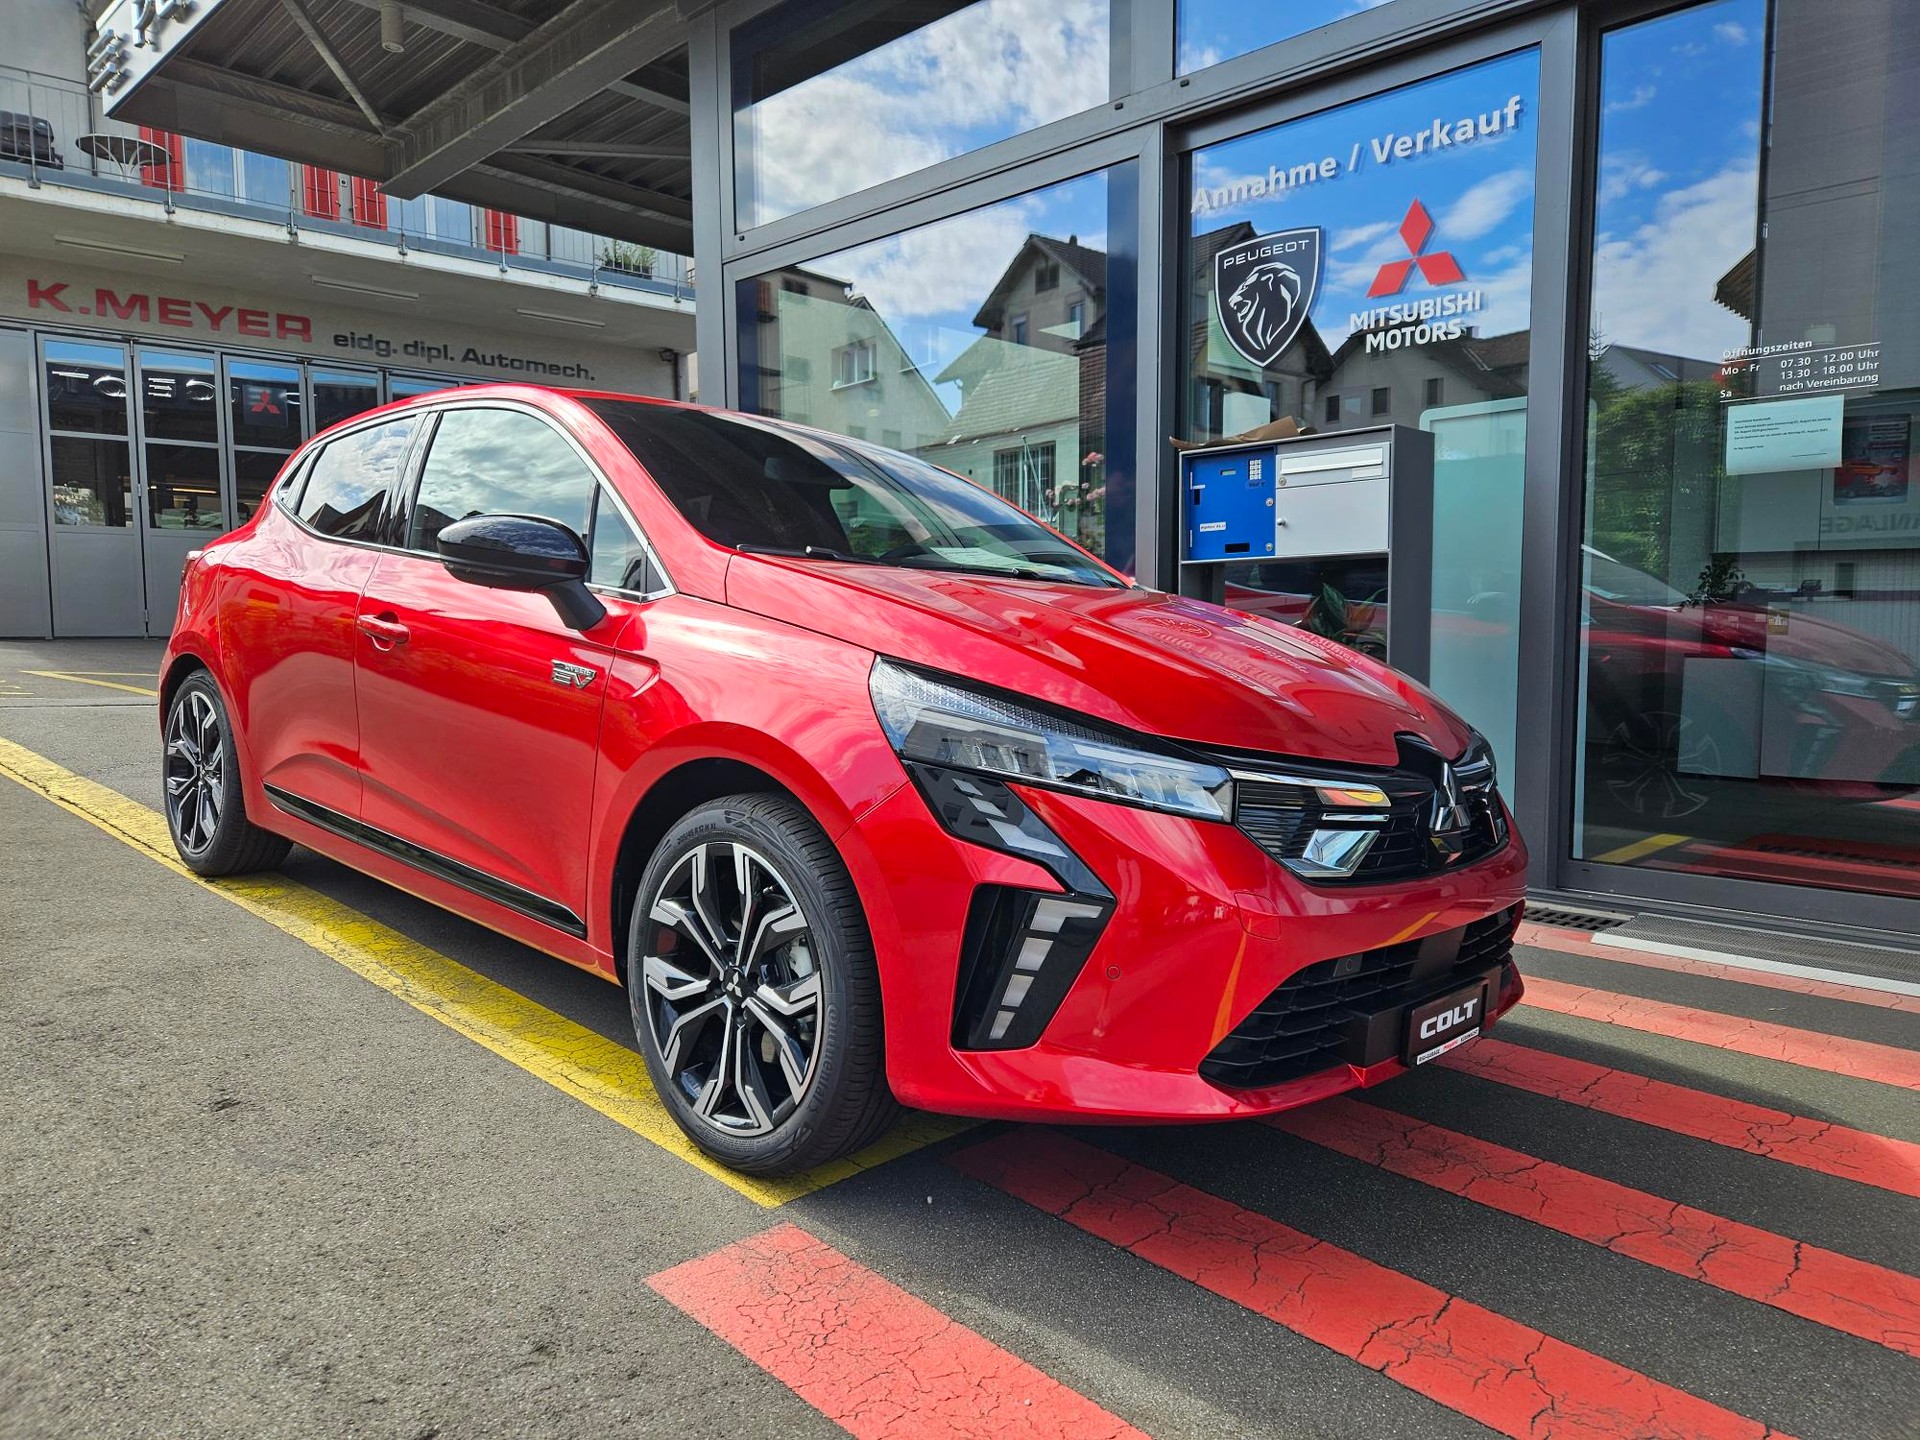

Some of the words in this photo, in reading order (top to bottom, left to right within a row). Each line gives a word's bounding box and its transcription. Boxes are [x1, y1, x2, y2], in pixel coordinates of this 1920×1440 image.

[1190, 155, 1337, 214] Annahme
[1348, 143, 1360, 172] /
[1371, 95, 1521, 164] Verkauf
[1223, 239, 1310, 269] PEUGEOT
[27, 279, 312, 342] K.MEYER
[1350, 290, 1480, 334] MITSUBISHI
[1365, 318, 1461, 353] MOTORS
[333, 331, 398, 358] eidg.
[403, 340, 455, 363] dipl.
[461, 348, 596, 381] Automech.
[1721, 366, 1739, 376] Mo
[1750, 363, 1761, 372] Fr
[1780, 356, 1811, 369] 07.30
[1824, 351, 1854, 363] 12.00
[1858, 348, 1880, 359] Uhr
[1780, 368, 1811, 380] 13.30
[1823, 363, 1854, 375] 18.00
[1858, 360, 1880, 371] Uhr
[1719, 389, 1732, 399] Sa
[1779, 381, 1804, 392] nach
[1806, 373, 1879, 389] Vereinbarung
[1420, 997, 1478, 1040] COLT
